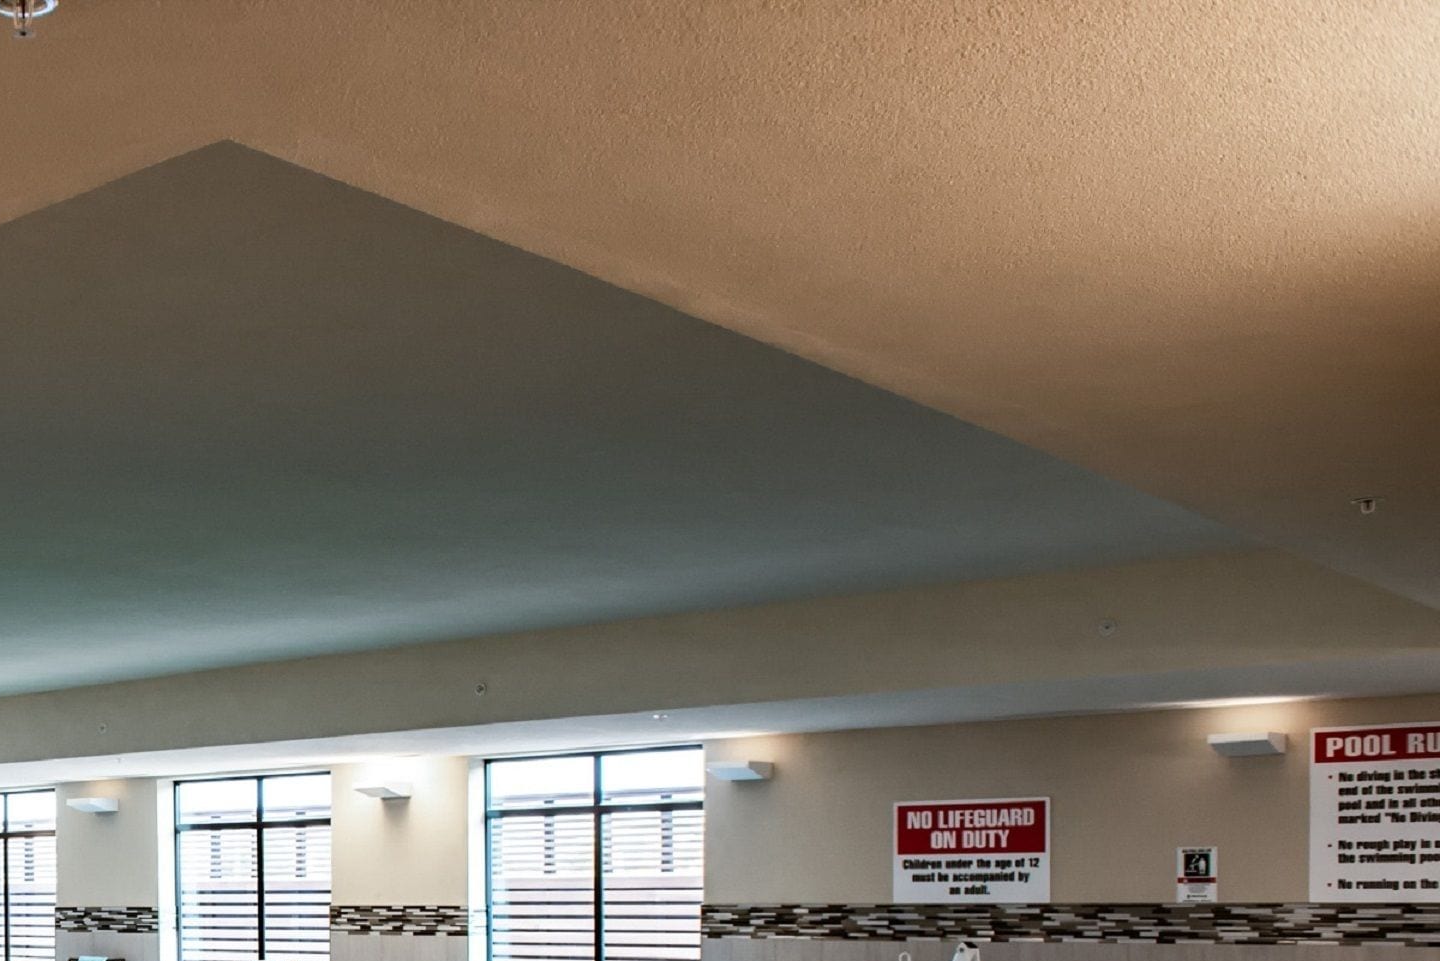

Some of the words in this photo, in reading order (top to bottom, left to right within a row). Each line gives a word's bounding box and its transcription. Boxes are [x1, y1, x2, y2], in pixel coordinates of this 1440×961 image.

[1326, 734, 1397, 757] POOL
[1406, 732, 1440, 753] RU
[1339, 772, 1354, 782] No
[1357, 771, 1390, 782] diving
[1394, 770, 1404, 780] in
[1408, 769, 1426, 779] the
[1338, 786, 1357, 796] end
[1362, 786, 1372, 795] of
[1376, 785, 1393, 794] the
[1338, 800, 1361, 811] pool
[1365, 799, 1385, 809] and
[1388, 799, 1398, 808] in
[1403, 798, 1416, 808] all
[907, 811, 932, 829] NO
[938, 808, 1034, 828] LIFEGUARD
[1338, 814, 1380, 823] marked
[1385, 813, 1405, 823] "No
[931, 831, 956, 849] ON
[962, 830, 1009, 848] DUTY
[1338, 840, 1353, 850] No
[1356, 840, 1389, 851] rough
[1393, 840, 1417, 851] play
[1421, 839, 1431, 848] in
[903, 859, 941, 869] Children
[946, 860, 973, 868] under
[977, 859, 991, 868] the
[995, 860, 1011, 869] age
[1015, 858, 1025, 867] of
[1029, 858, 1039, 867] 12
[1338, 853, 1355, 863] the
[1359, 853, 1415, 864] swimming
[912, 873, 934, 882] must
[938, 872, 948, 882] be
[953, 872, 1014, 882] accompanied
[1018, 872, 1030, 882] by
[949, 886, 960, 895] an
[964, 885, 990, 895] adult.
[1338, 879, 1352, 889] No
[1356, 879, 1399, 890] running
[1403, 880, 1416, 889] on
[1421, 879, 1438, 889] the
